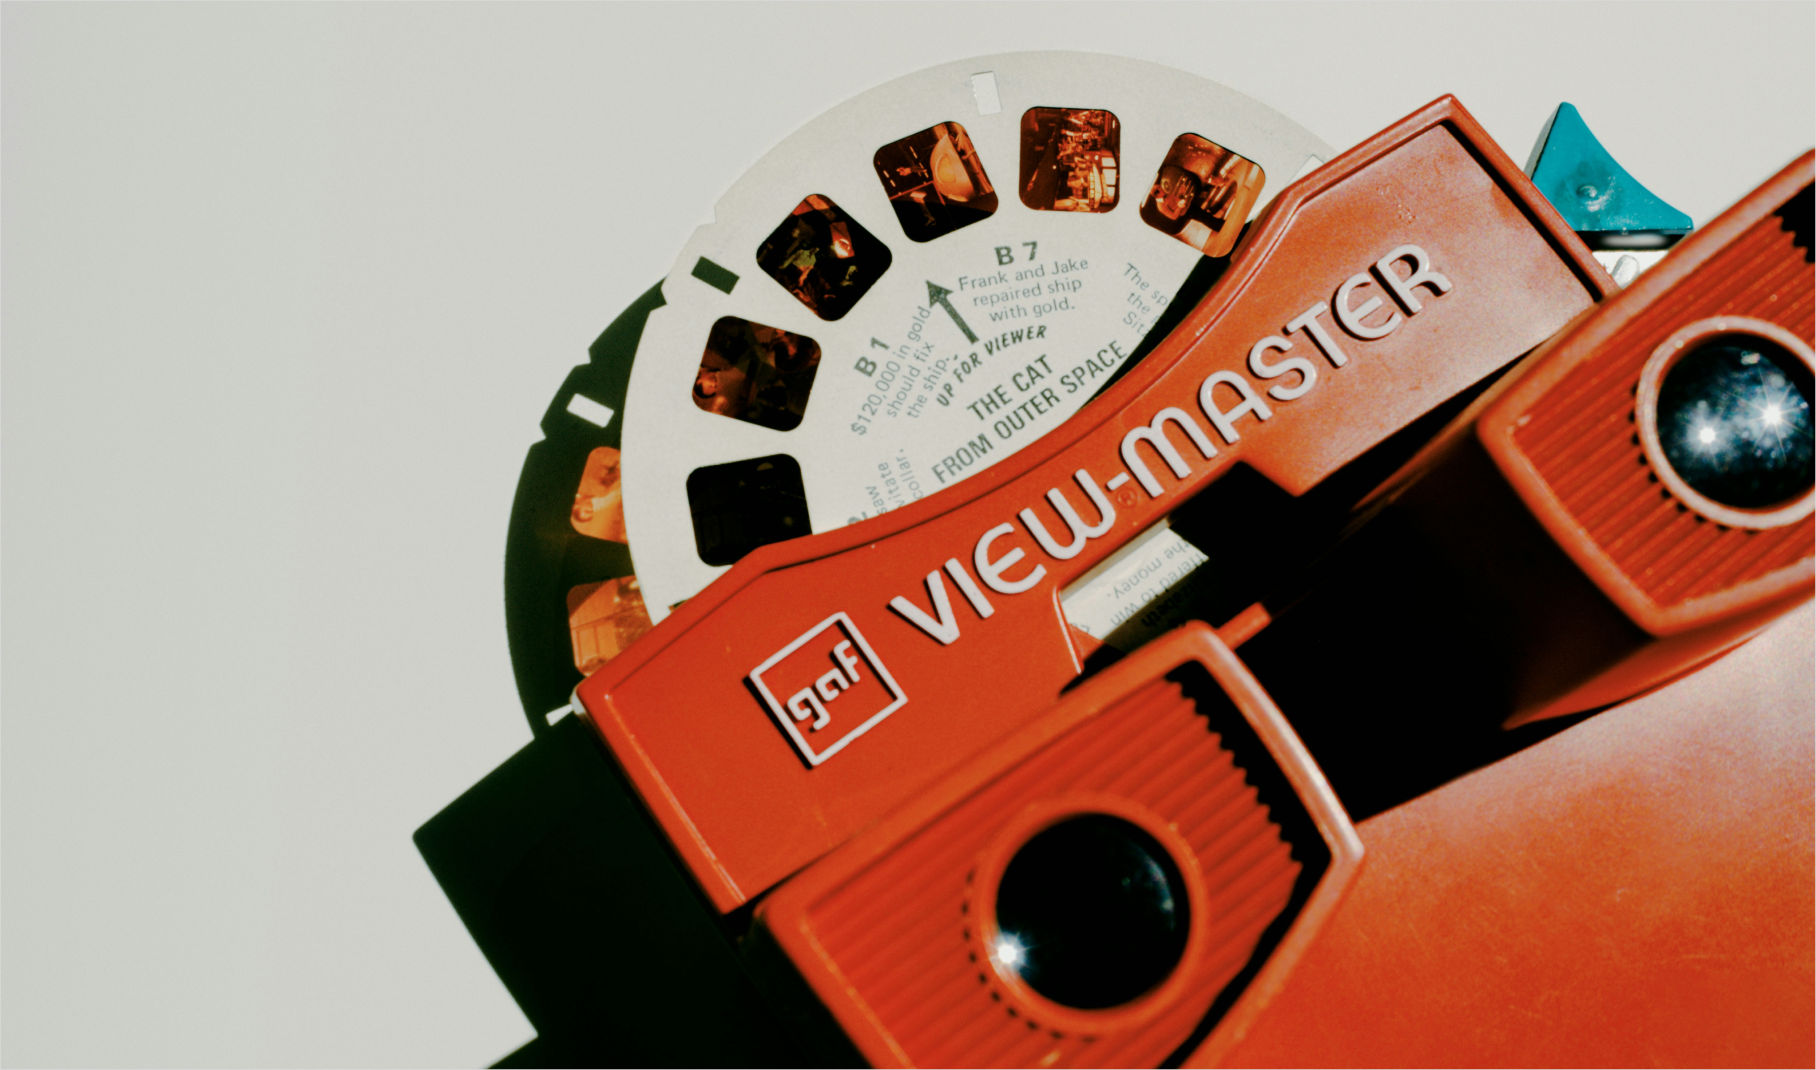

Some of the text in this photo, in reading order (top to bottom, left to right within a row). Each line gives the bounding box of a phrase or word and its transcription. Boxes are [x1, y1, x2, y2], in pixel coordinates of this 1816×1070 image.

[994, 241, 1038, 266] B 7
[958, 258, 1089, 291] Frank and Jake
[973, 277, 1082, 307] repaired ship
[1124, 262, 1150, 291] The
[989, 296, 1076, 322] with gold.
[1127, 292, 1151, 315] the
[851, 305, 931, 436] $120,000 in gold
[854, 337, 890, 378] B 1
[936, 325, 1047, 407] UP FOR VIEWER
[887, 341, 935, 418] should fix
[907, 357, 950, 419] the ship.
[966, 354, 1053, 421] THE CAT
[931, 340, 1127, 484] FROM OUTER SPACE
[888, 243, 1452, 645] VIEW-MASTER
[1107, 557, 1163, 599] money.
[1140, 588, 1159, 601] to
[1109, 602, 1139, 626] win
[787, 639, 861, 731] gaf
